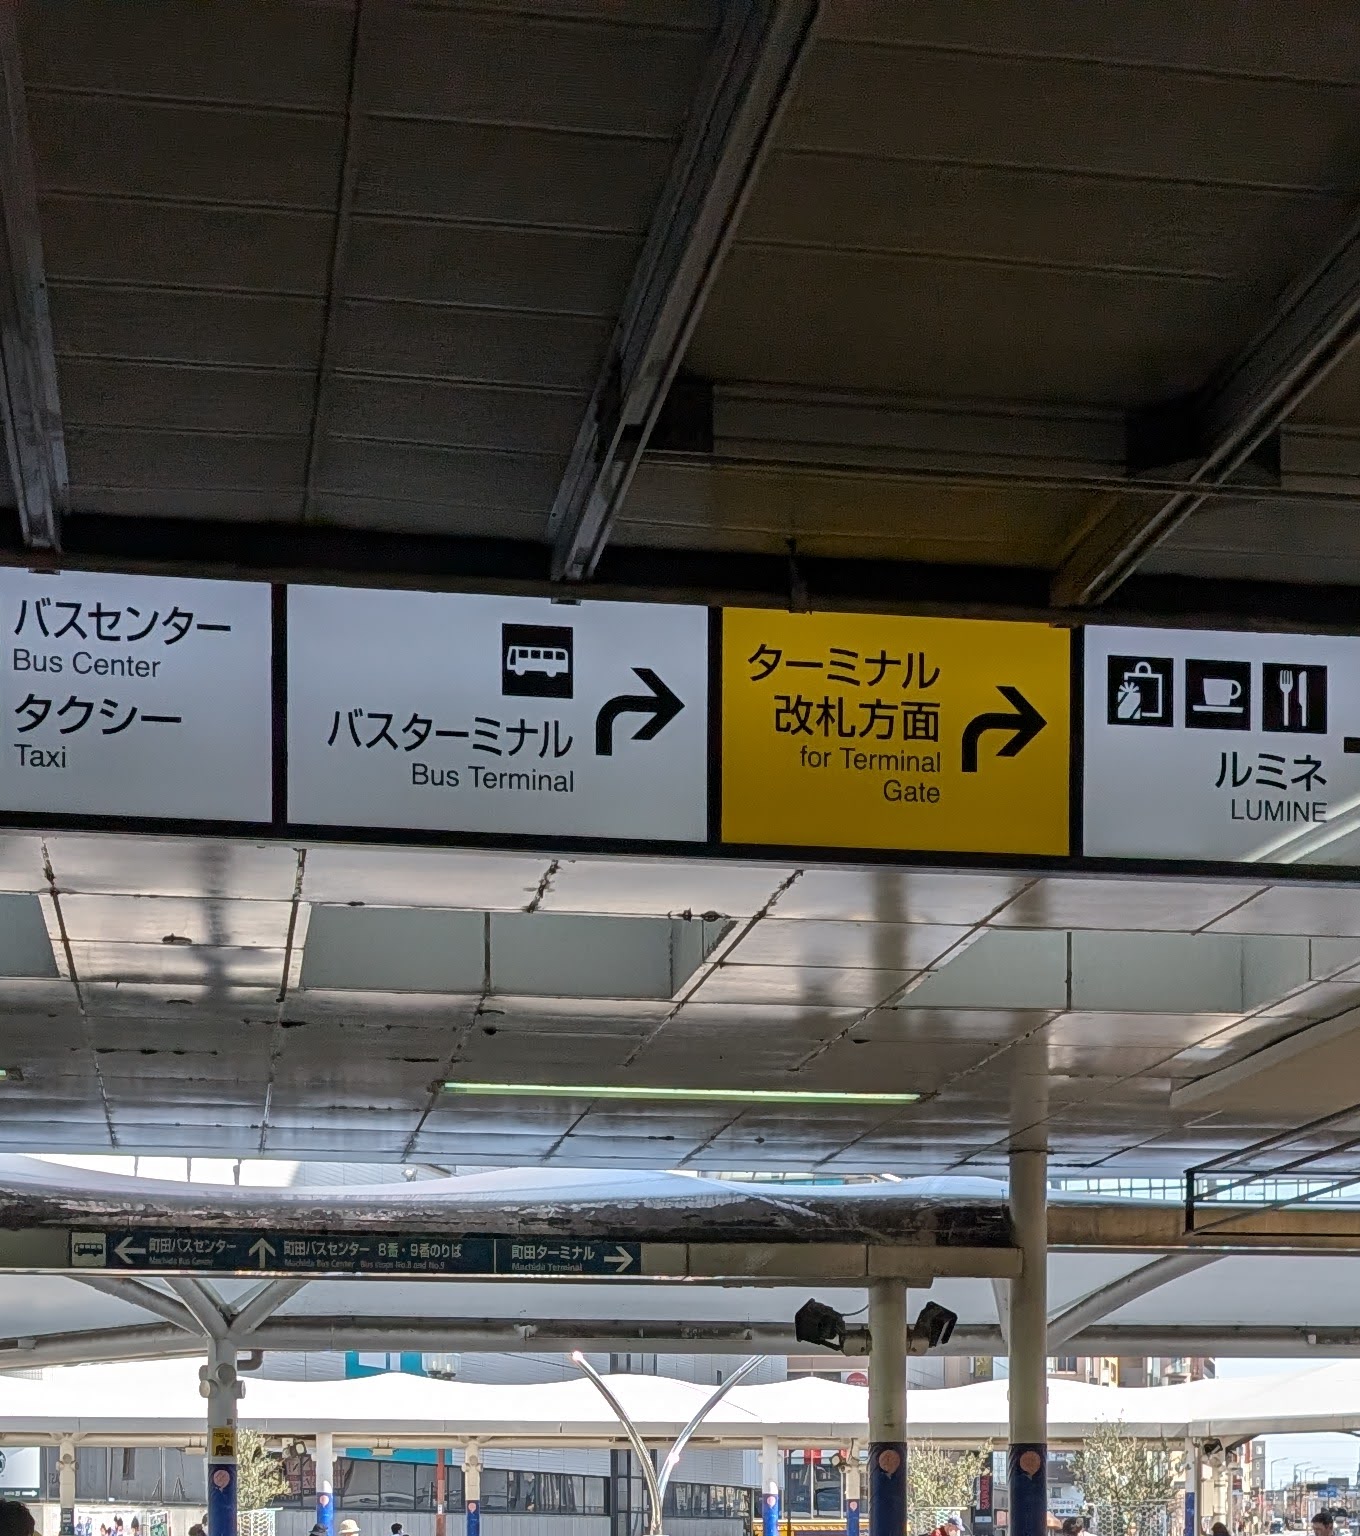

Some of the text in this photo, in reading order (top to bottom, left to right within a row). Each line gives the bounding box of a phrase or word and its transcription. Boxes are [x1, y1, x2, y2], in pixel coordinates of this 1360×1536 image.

[14, 597, 233, 646] バスセンター
[14, 649, 162, 678] Bus Center
[747, 643, 941, 691] ターミナル
[14, 694, 182, 735] タクシー
[774, 694, 940, 743] 改札方面
[327, 709, 574, 760] バスターミナル
[14, 744, 68, 769] Taxi
[800, 747, 941, 774] for Terminal
[411, 763, 575, 794] Bus Terminal
[1214, 751, 1328, 792] ルミネ
[883, 779, 941, 805] Gate
[1231, 798, 1328, 824] LUMINE
[148, 1237, 237, 1255] 町田バスセンター
[283, 1240, 371, 1257] 町田バスセンター
[511, 1244, 595, 1261] 町田ターミナル
[330, 1260, 355, 1269] Center
[511, 1262, 583, 1272] Machida Terminal
